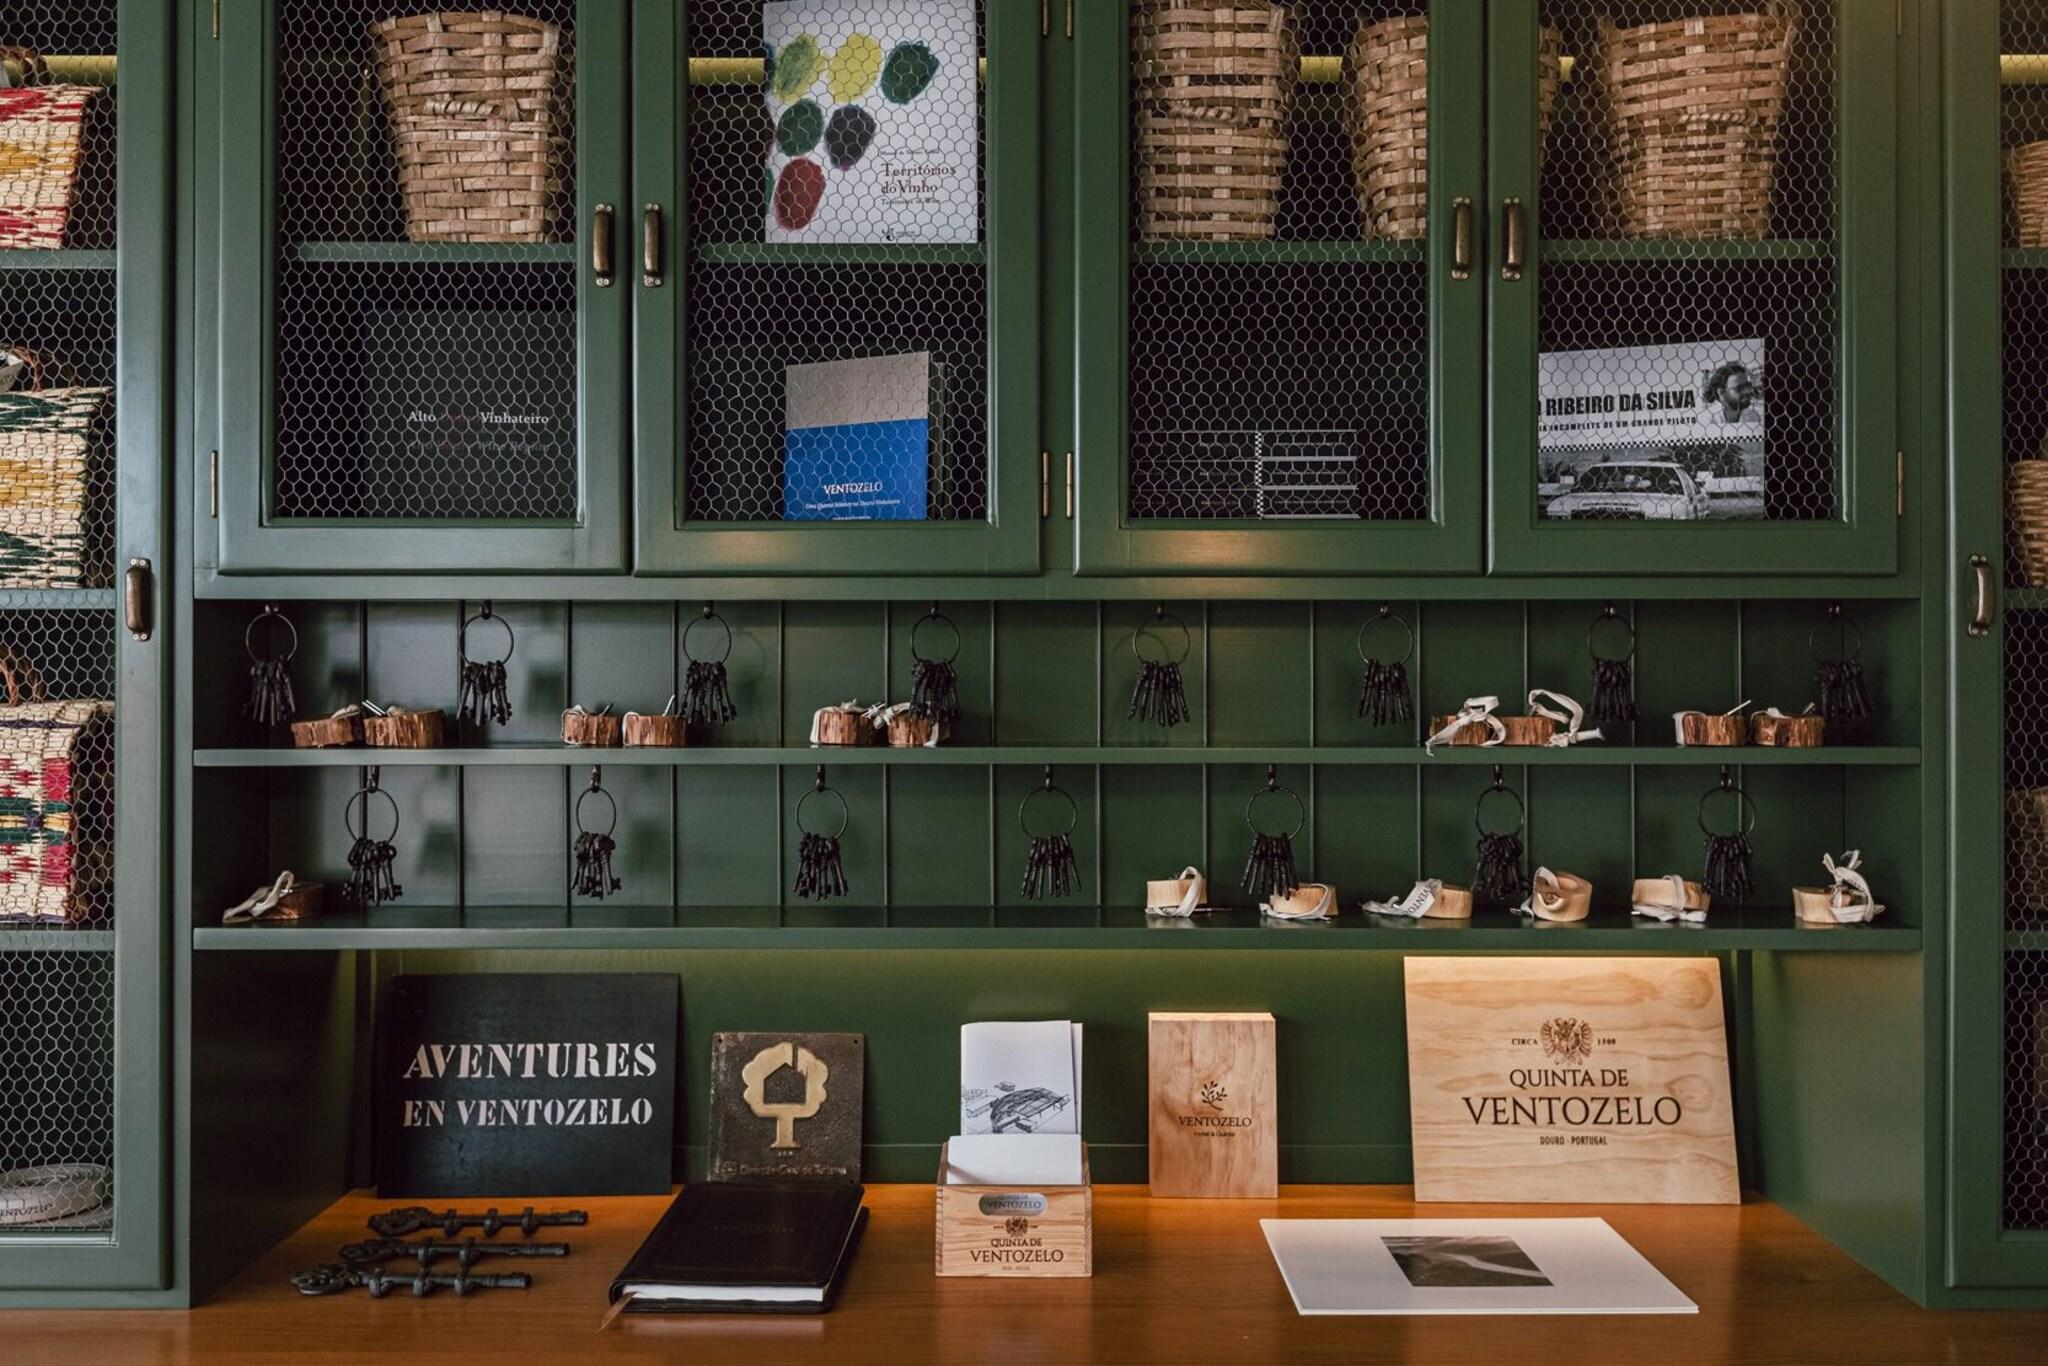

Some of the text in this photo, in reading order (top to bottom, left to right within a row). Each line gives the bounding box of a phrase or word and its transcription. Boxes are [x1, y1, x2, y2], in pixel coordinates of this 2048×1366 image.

[881, 180, 937, 193] do Vinho
[1546, 395, 1614, 416] RIBEIRO
[1619, 393, 1643, 412] DA
[1646, 390, 1696, 410] SILVA
[408, 410, 436, 422] Alto
[480, 411, 549, 424] Vinhateiro
[823, 481, 883, 494] VENTOZELO
[402, 1042, 657, 1079] AVENTURES
[1510, 1068, 1629, 1089] QUINTA DE
[403, 1097, 653, 1127] EN VENTOZELO
[1461, 1096, 1682, 1126] VENTOZELO
[1178, 1115, 1252, 1128] VENTOZELO
[1539, 1136, 1608, 1146] DOURO PORTUGAL
[987, 1199, 1042, 1209] VENTOZELO
[991, 1238, 1042, 1248] QUINTA DE
[970, 1249, 1064, 1263] VENTOZELO
